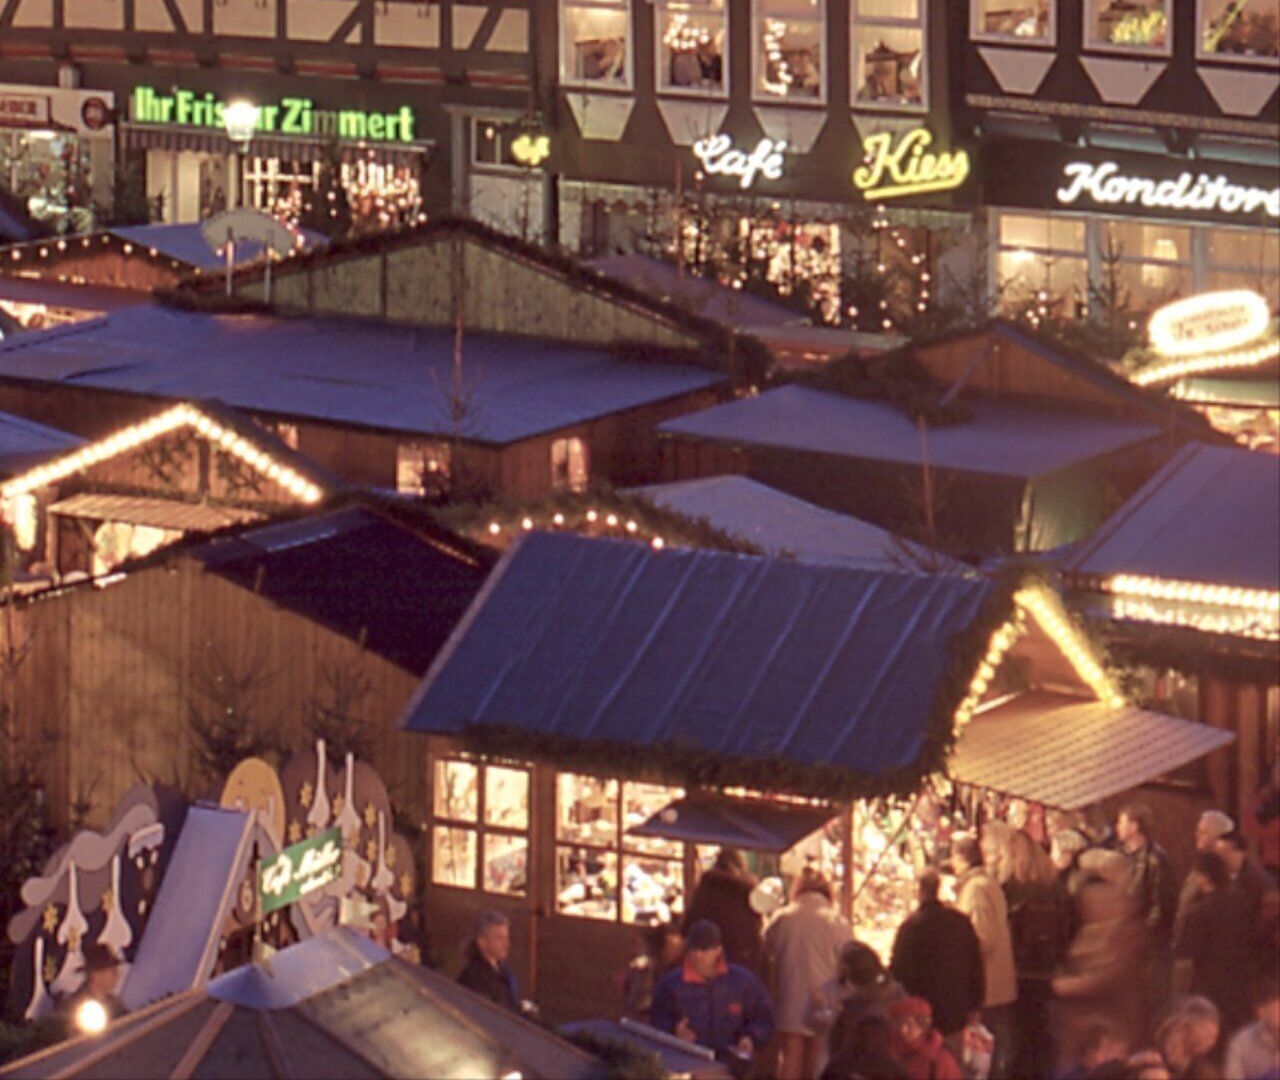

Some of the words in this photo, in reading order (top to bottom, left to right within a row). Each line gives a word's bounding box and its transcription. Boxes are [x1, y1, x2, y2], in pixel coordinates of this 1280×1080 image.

[134, 86, 174, 123] Ihr
[281, 97, 414, 142] Zimmert
[693, 134, 787, 188] Café
